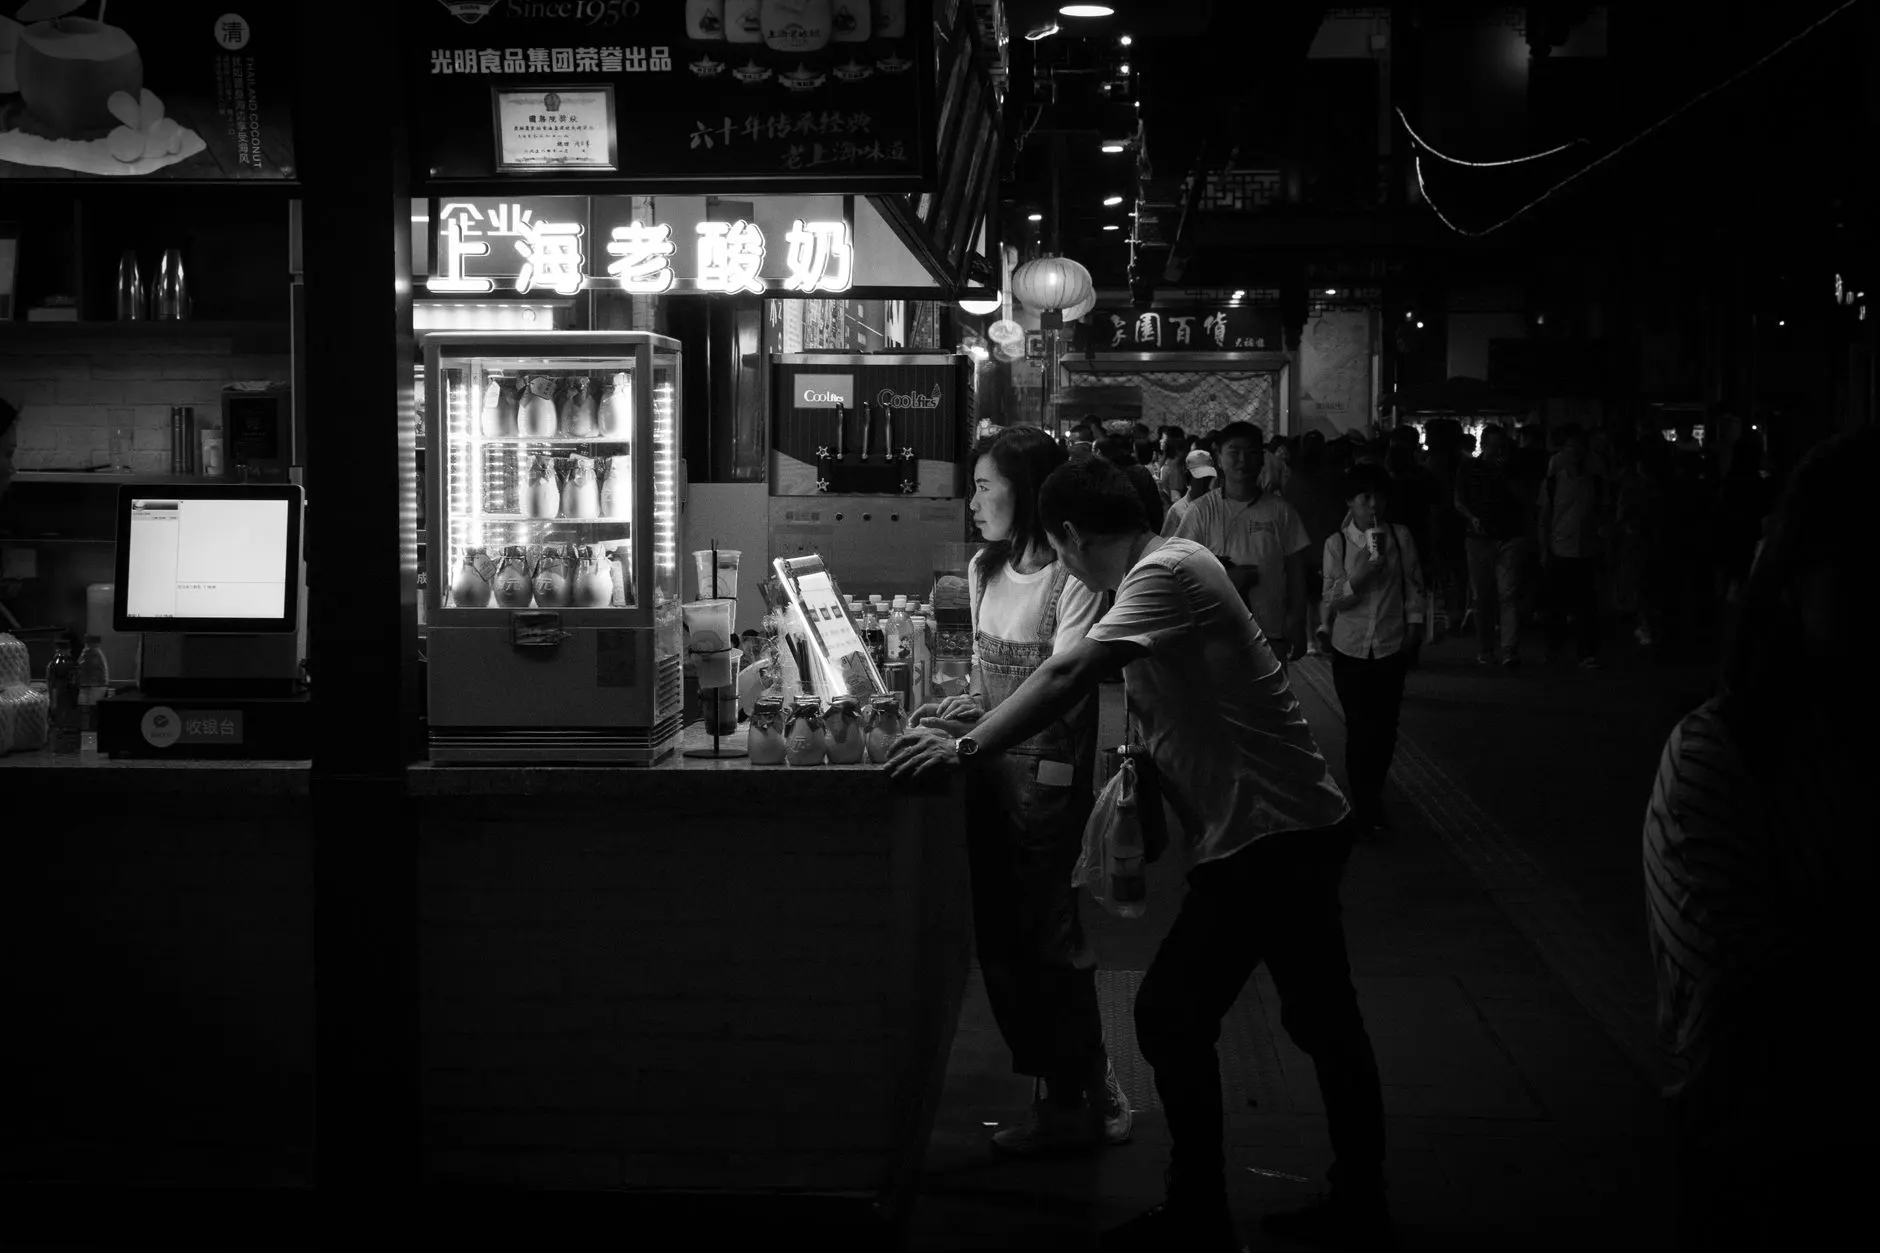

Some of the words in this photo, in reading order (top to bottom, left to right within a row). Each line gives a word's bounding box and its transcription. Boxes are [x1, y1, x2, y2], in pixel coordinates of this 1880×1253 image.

[222, 22, 243, 43] 清
[430, 46, 673, 75] 光明食品集团荣誉出品
[246, 56, 258, 111] THAILAND
[249, 113, 262, 169] COCONUT
[689, 109, 874, 151] 六十年传承经典
[780, 139, 907, 170] 老上海味道
[426, 218, 856, 295] 上海老酸奶
[185, 717, 235, 736] 收银台
